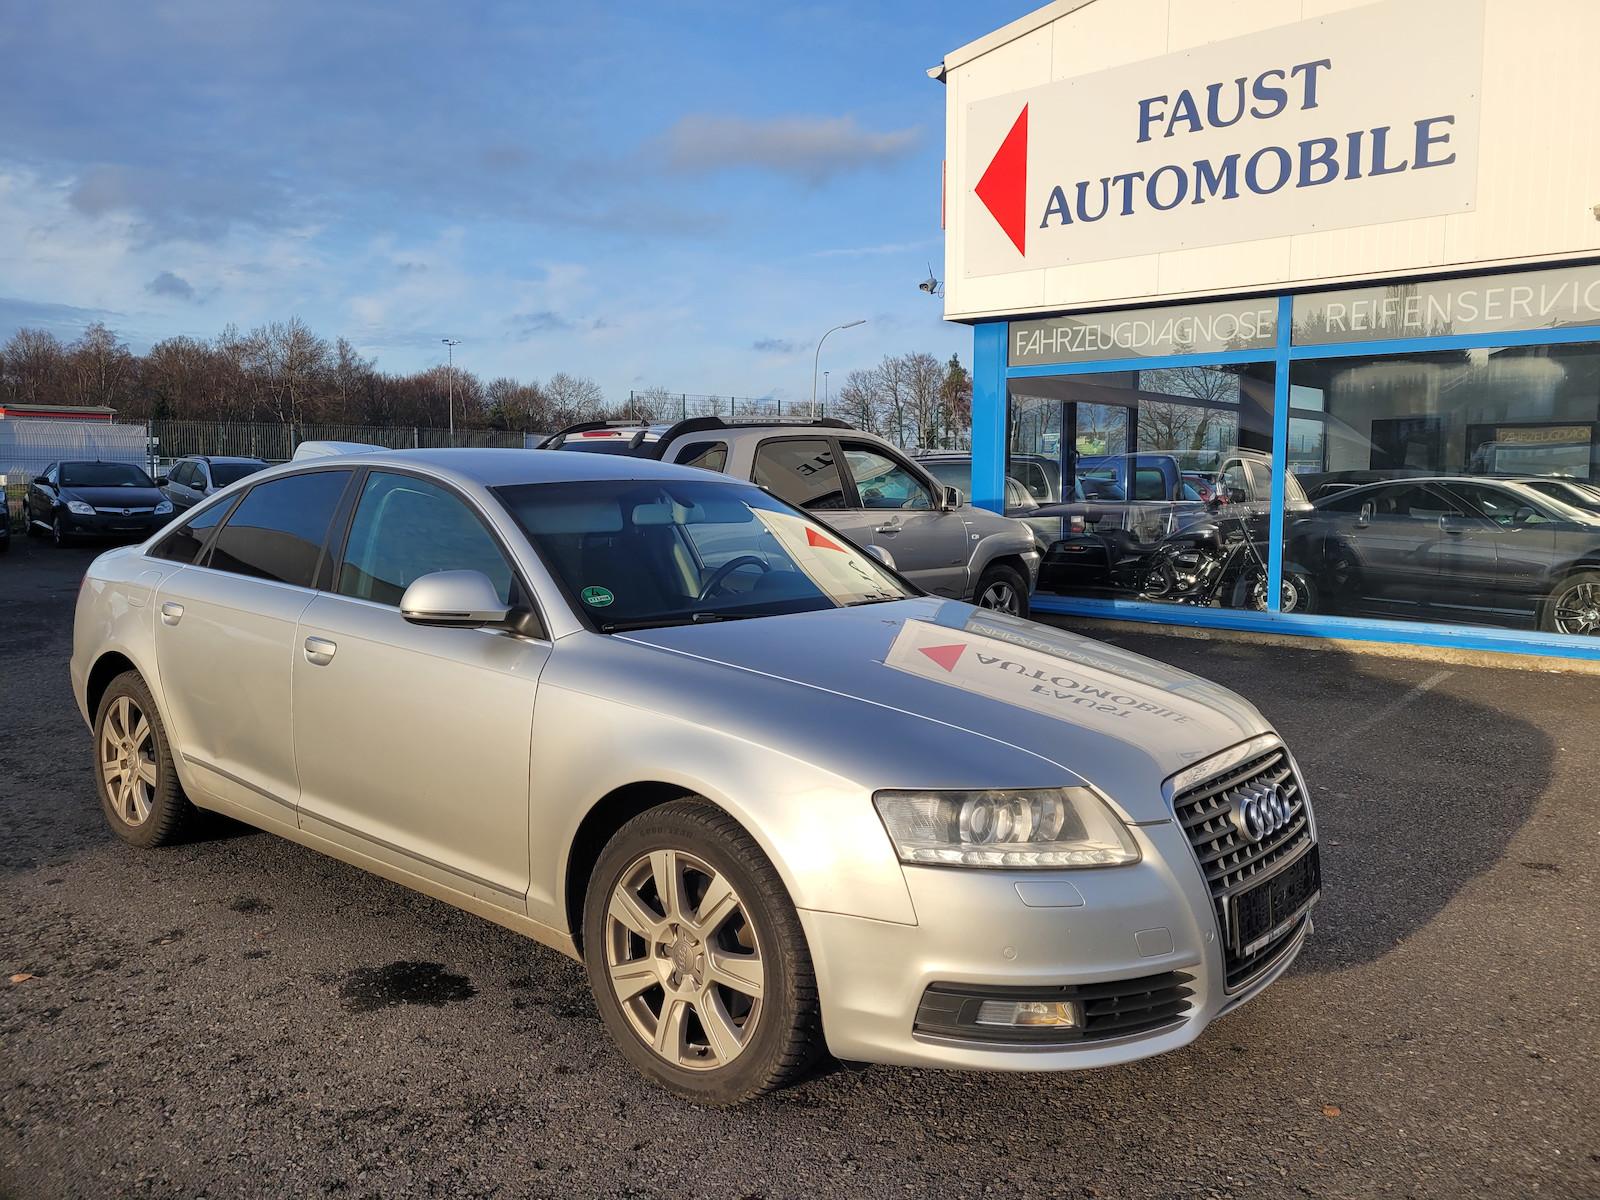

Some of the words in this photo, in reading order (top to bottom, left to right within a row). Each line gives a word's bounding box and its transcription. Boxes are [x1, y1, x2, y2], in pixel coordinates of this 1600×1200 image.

[1137, 59, 1331, 143] FAUST
[1040, 115, 1455, 228] AUTOMOBILE
[1016, 310, 1273, 356] FAHRZEUGDIAGNOSE
